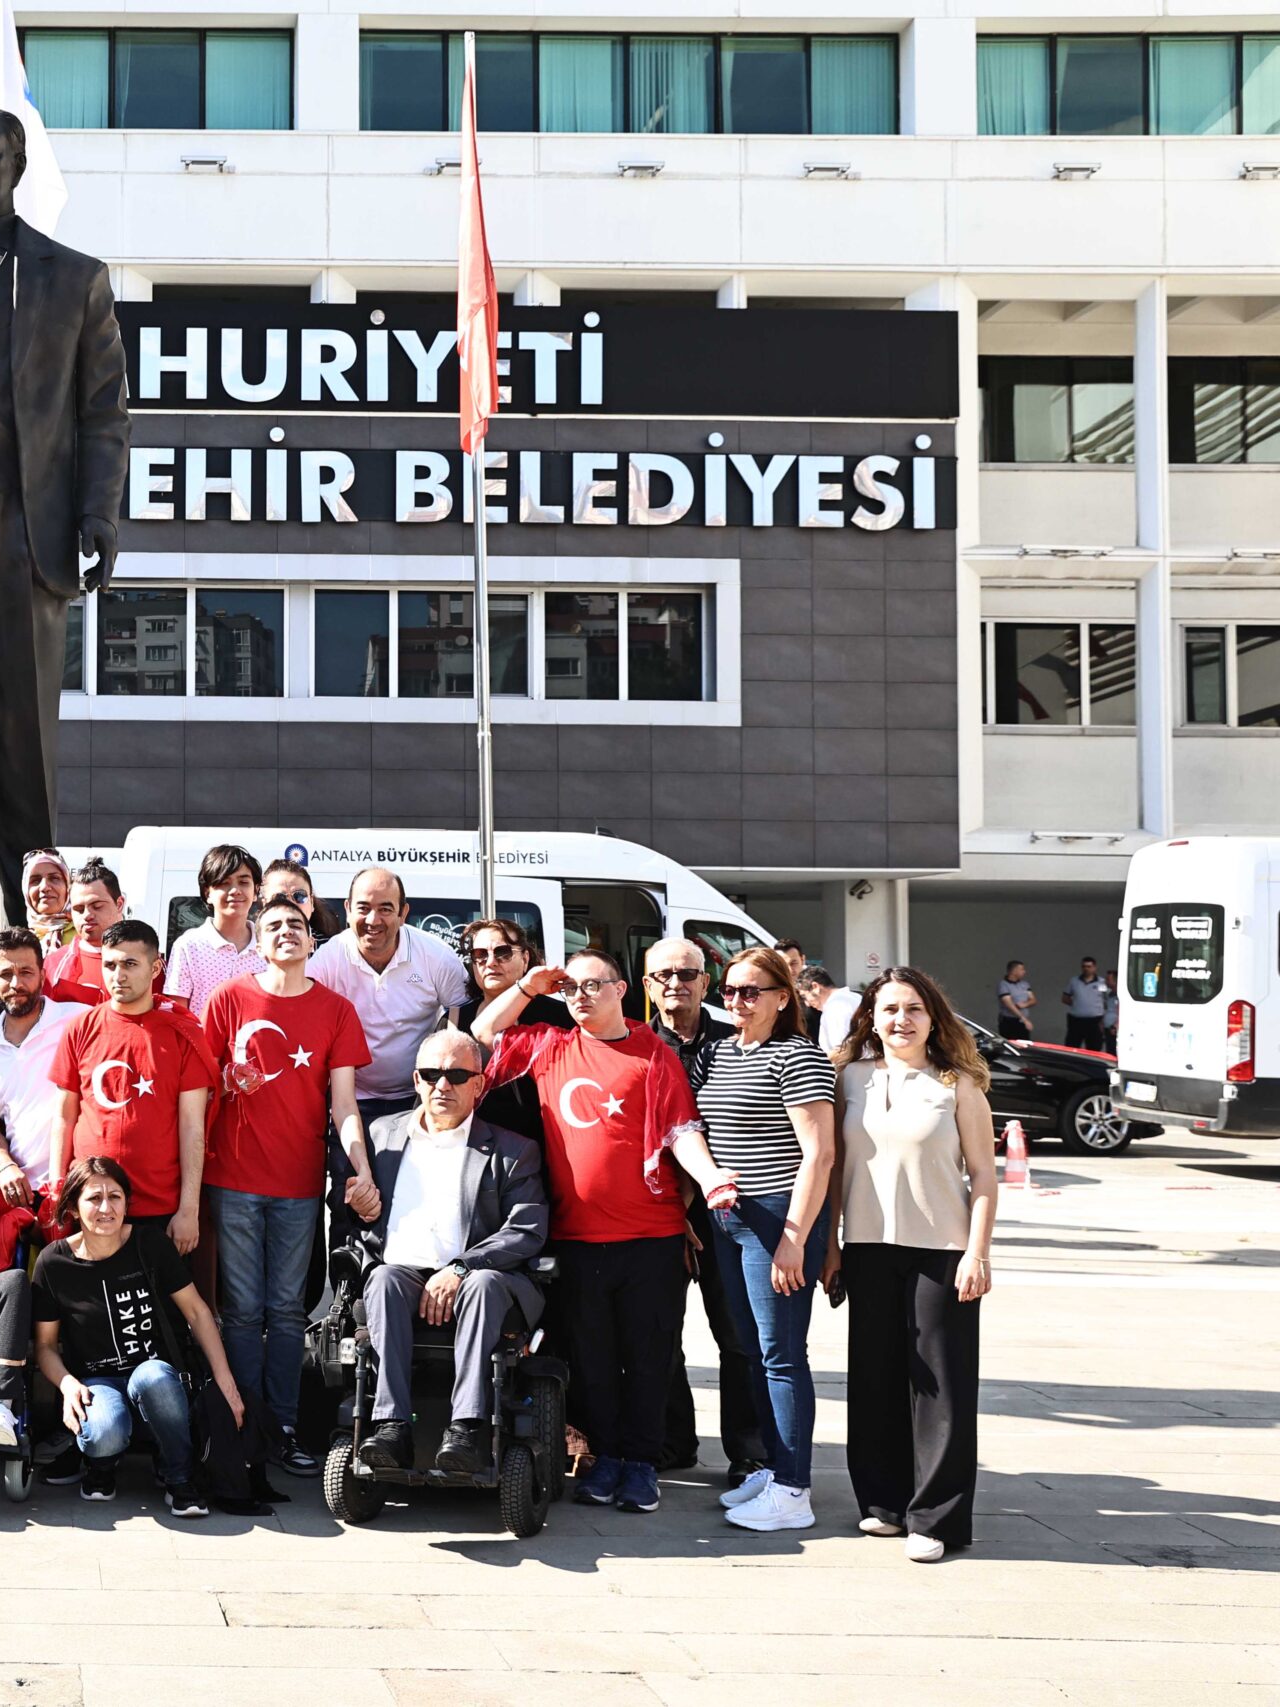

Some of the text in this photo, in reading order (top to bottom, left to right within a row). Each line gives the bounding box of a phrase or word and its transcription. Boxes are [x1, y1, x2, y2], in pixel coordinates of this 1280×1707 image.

[396, 432, 936, 532] BELEDİYESİ
[311, 848, 549, 865] ANTALYA BÜYÜKŞEHİR BLEDİYESİ
